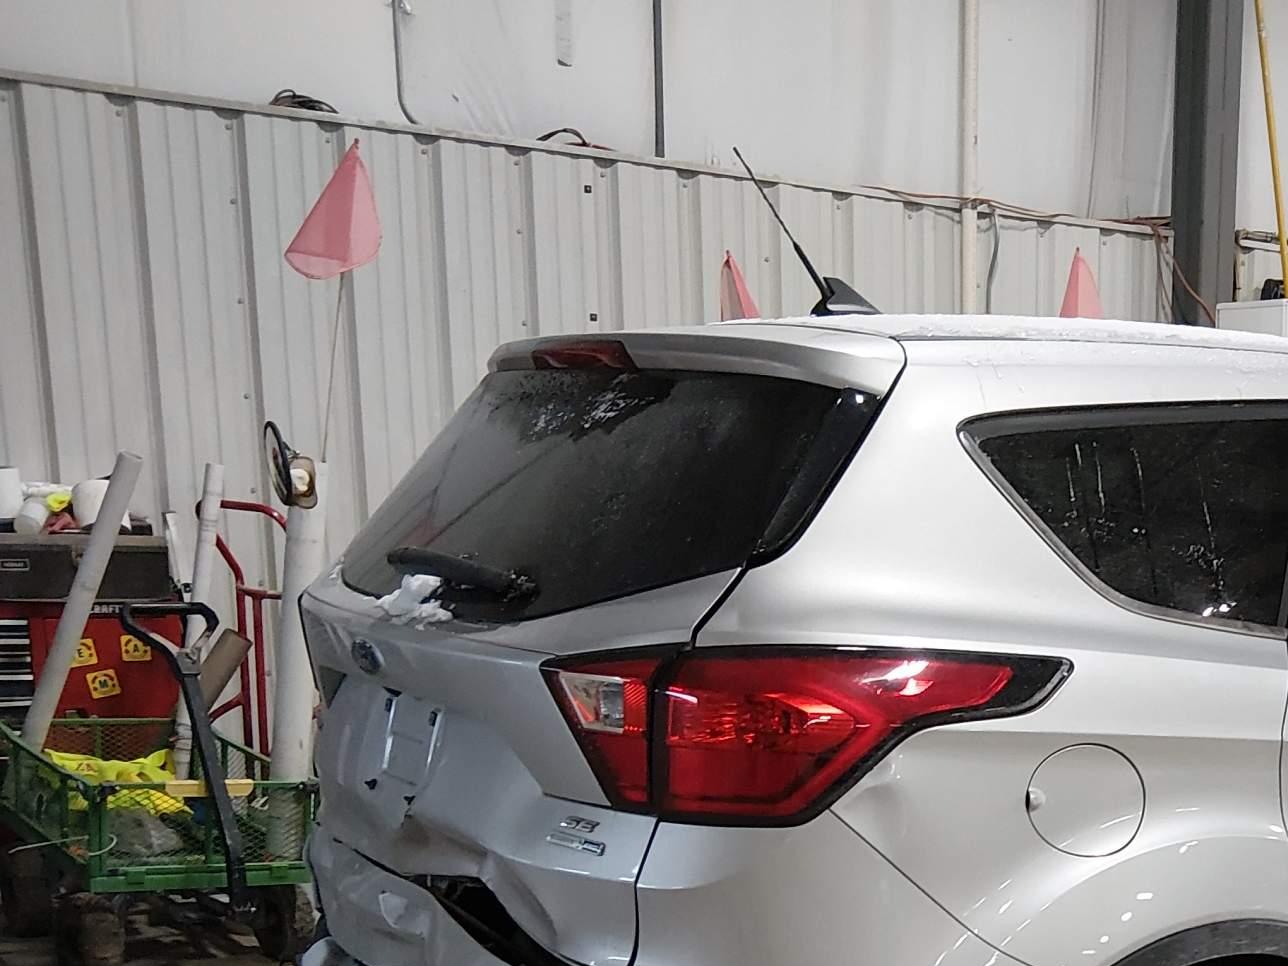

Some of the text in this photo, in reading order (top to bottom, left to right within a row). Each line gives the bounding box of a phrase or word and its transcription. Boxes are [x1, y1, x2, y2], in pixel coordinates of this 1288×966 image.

[77, 648, 85, 658] E
[132, 643, 140, 654] A
[560, 815, 601, 833] SE
